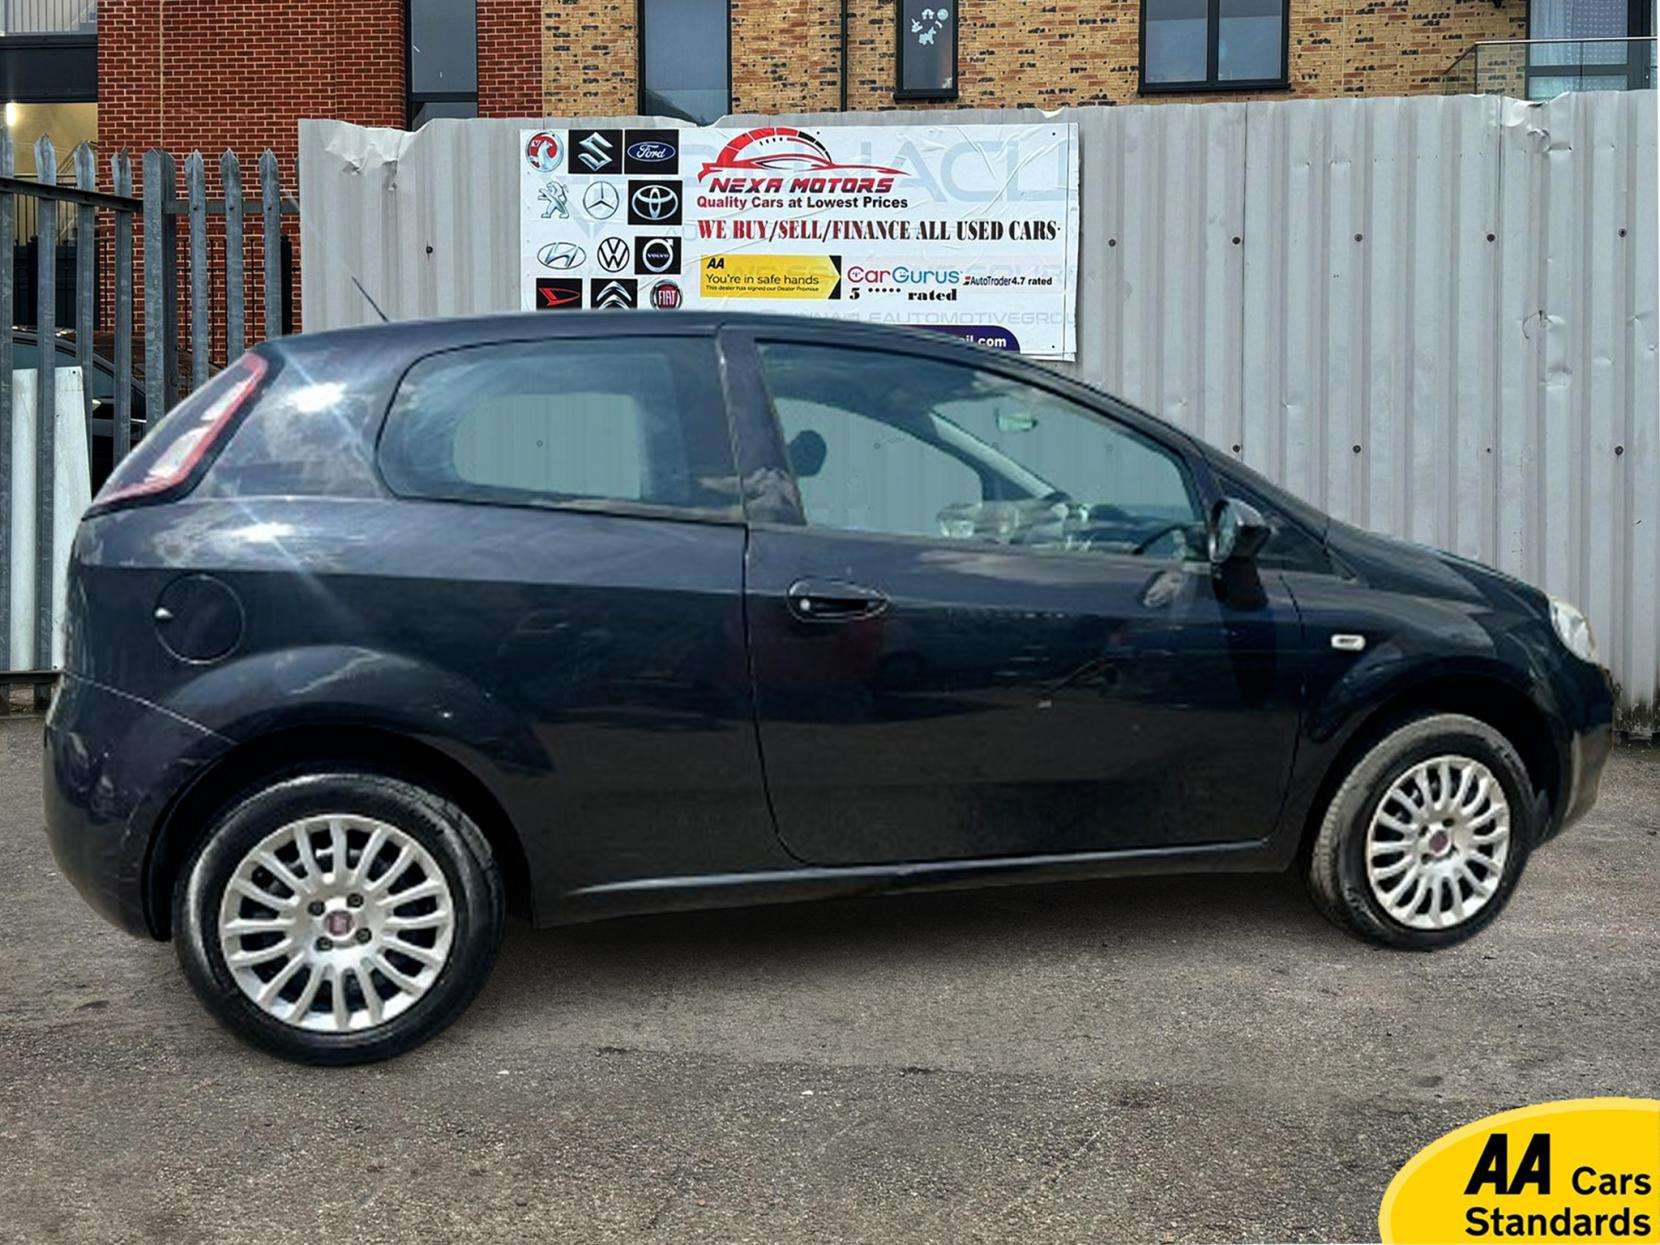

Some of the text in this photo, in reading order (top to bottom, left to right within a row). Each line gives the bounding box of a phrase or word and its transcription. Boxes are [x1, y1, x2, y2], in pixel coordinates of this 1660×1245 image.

[636, 144, 666, 159] Ford
[708, 177, 894, 193] NEXA MOTORS
[697, 196, 908, 210] Quality Cars at Lowest Prices
[697, 219, 727, 240] WE
[733, 219, 910, 243] BUY/SELL/FINANCE
[916, 220, 950, 240] ALL
[956, 220, 1004, 240] USED
[706, 257, 725, 270] AA
[705, 273, 819, 285] You're in safe hands
[847, 265, 960, 284] CarGurus
[1028, 276, 1053, 286] rated
[658, 289, 677, 306] FIAT
[849, 287, 957, 301] 5 rated
